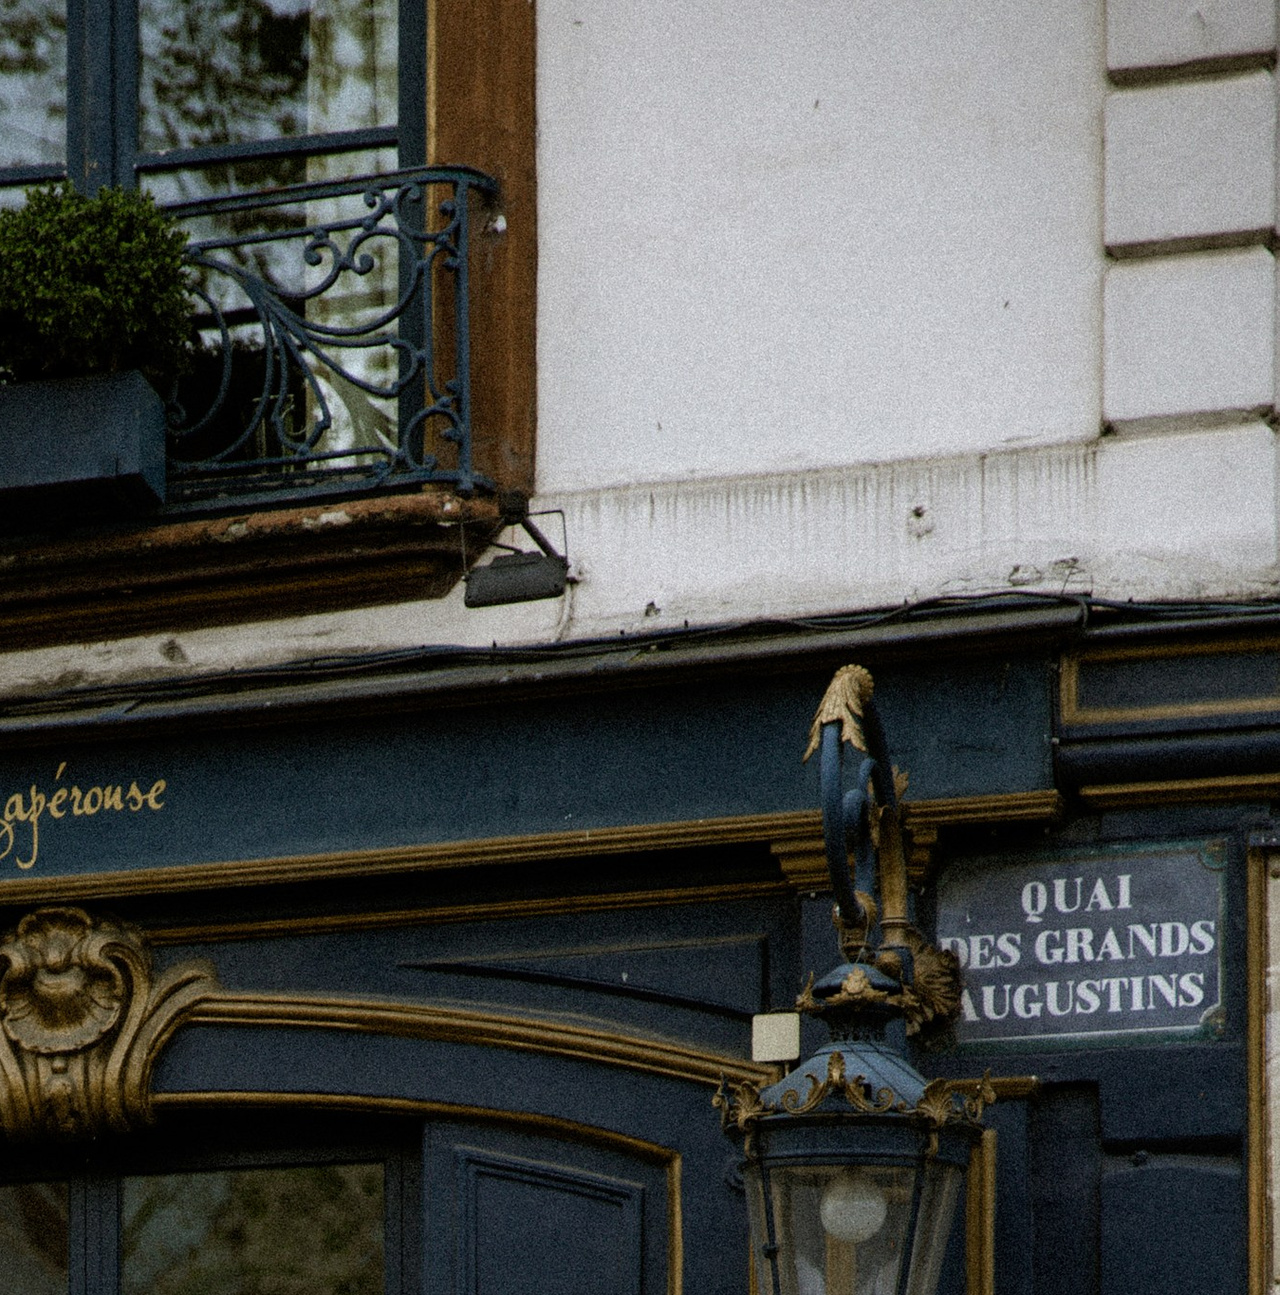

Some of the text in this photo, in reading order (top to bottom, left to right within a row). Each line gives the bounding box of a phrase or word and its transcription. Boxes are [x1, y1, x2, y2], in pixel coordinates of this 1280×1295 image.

[1021, 873, 1133, 923] QUAI
[939, 920, 1217, 970] DES GRANDS
